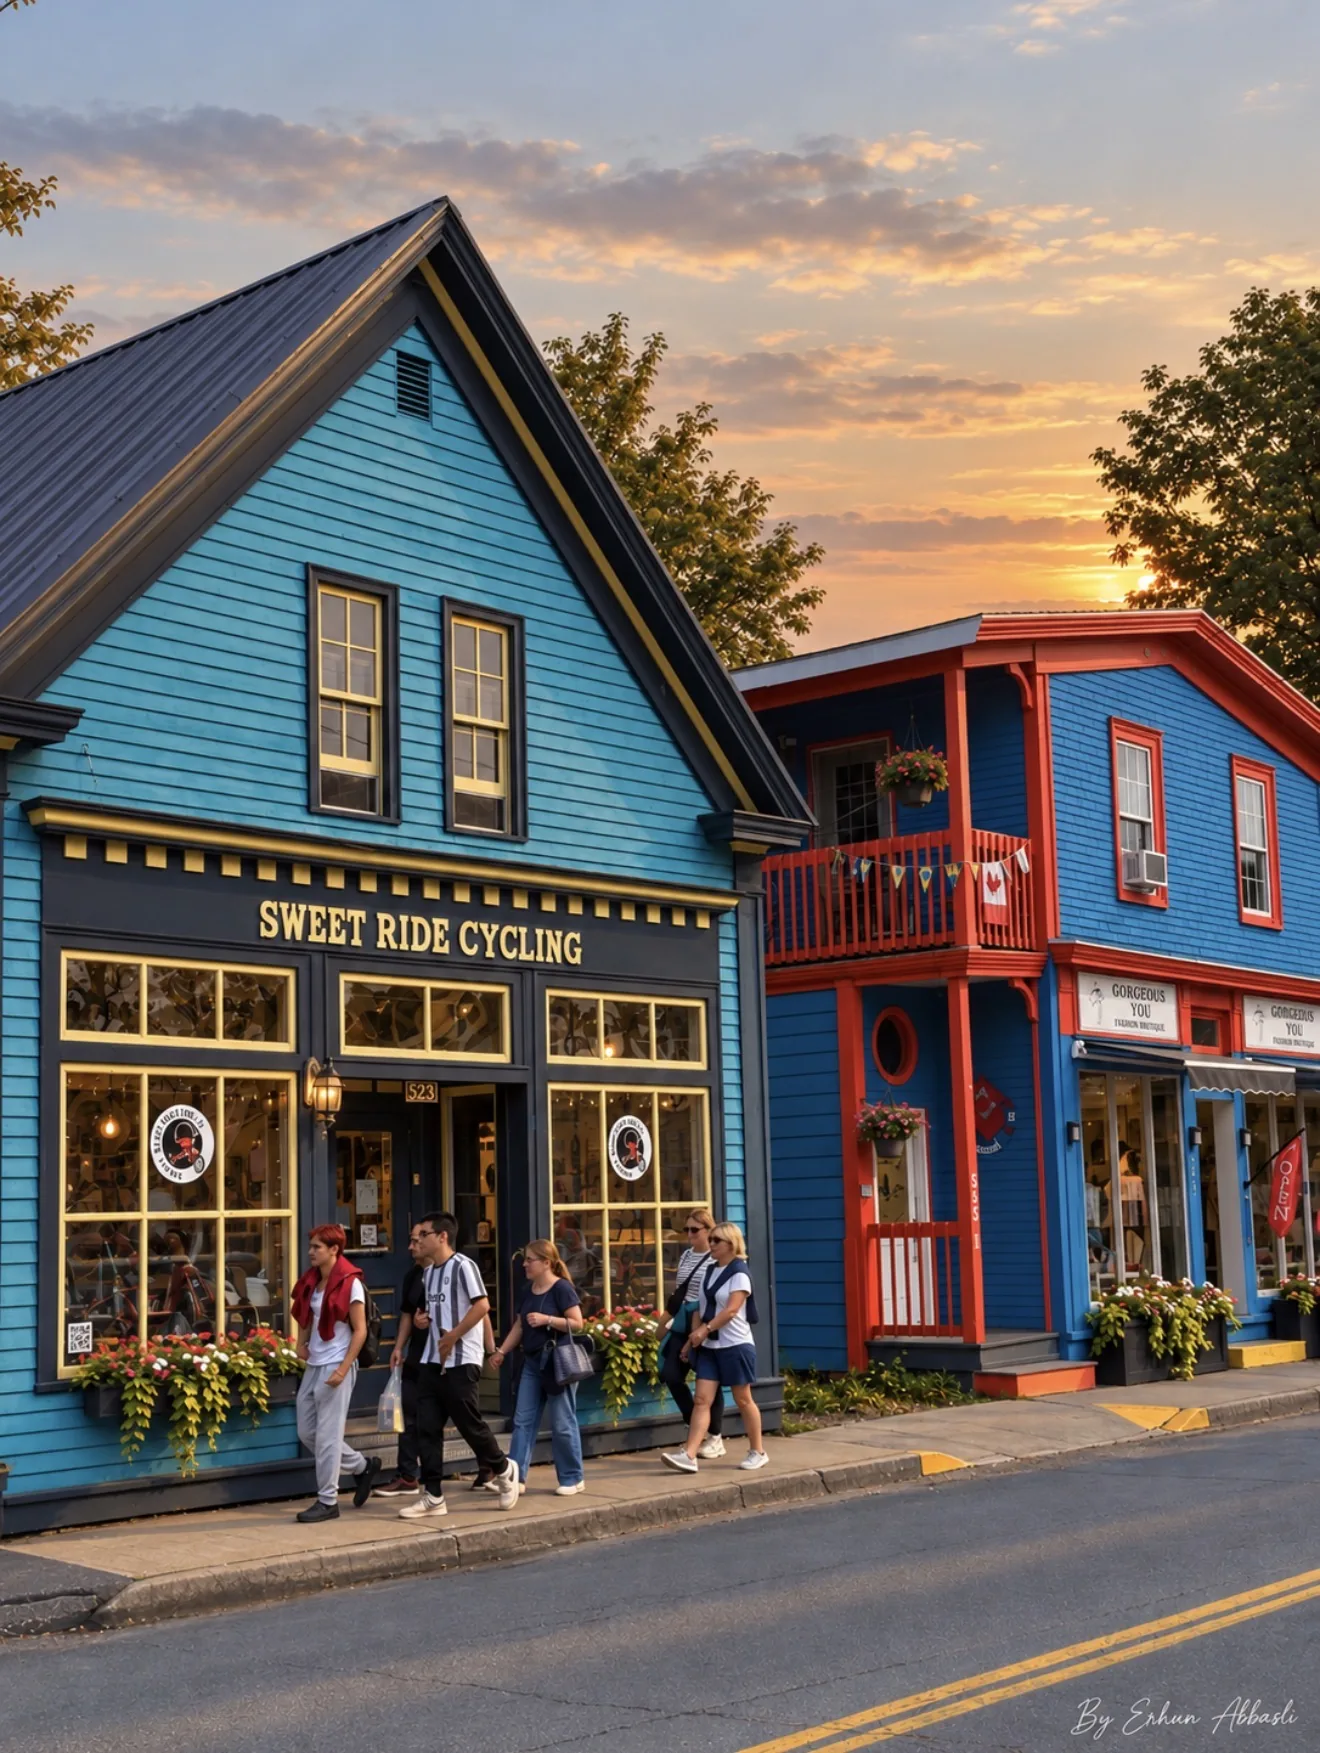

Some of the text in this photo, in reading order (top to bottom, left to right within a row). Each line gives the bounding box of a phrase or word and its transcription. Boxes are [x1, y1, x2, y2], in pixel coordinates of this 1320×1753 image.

[259, 899, 583, 965] SWEET RIDE CYCLING
[1112, 983, 1166, 1003] GORGEOUS
[1130, 1003, 1151, 1018] YOU
[1285, 1022, 1304, 1036] YOU
[409, 1083, 435, 1100] 523
[1273, 1160, 1293, 1222] OPEN
